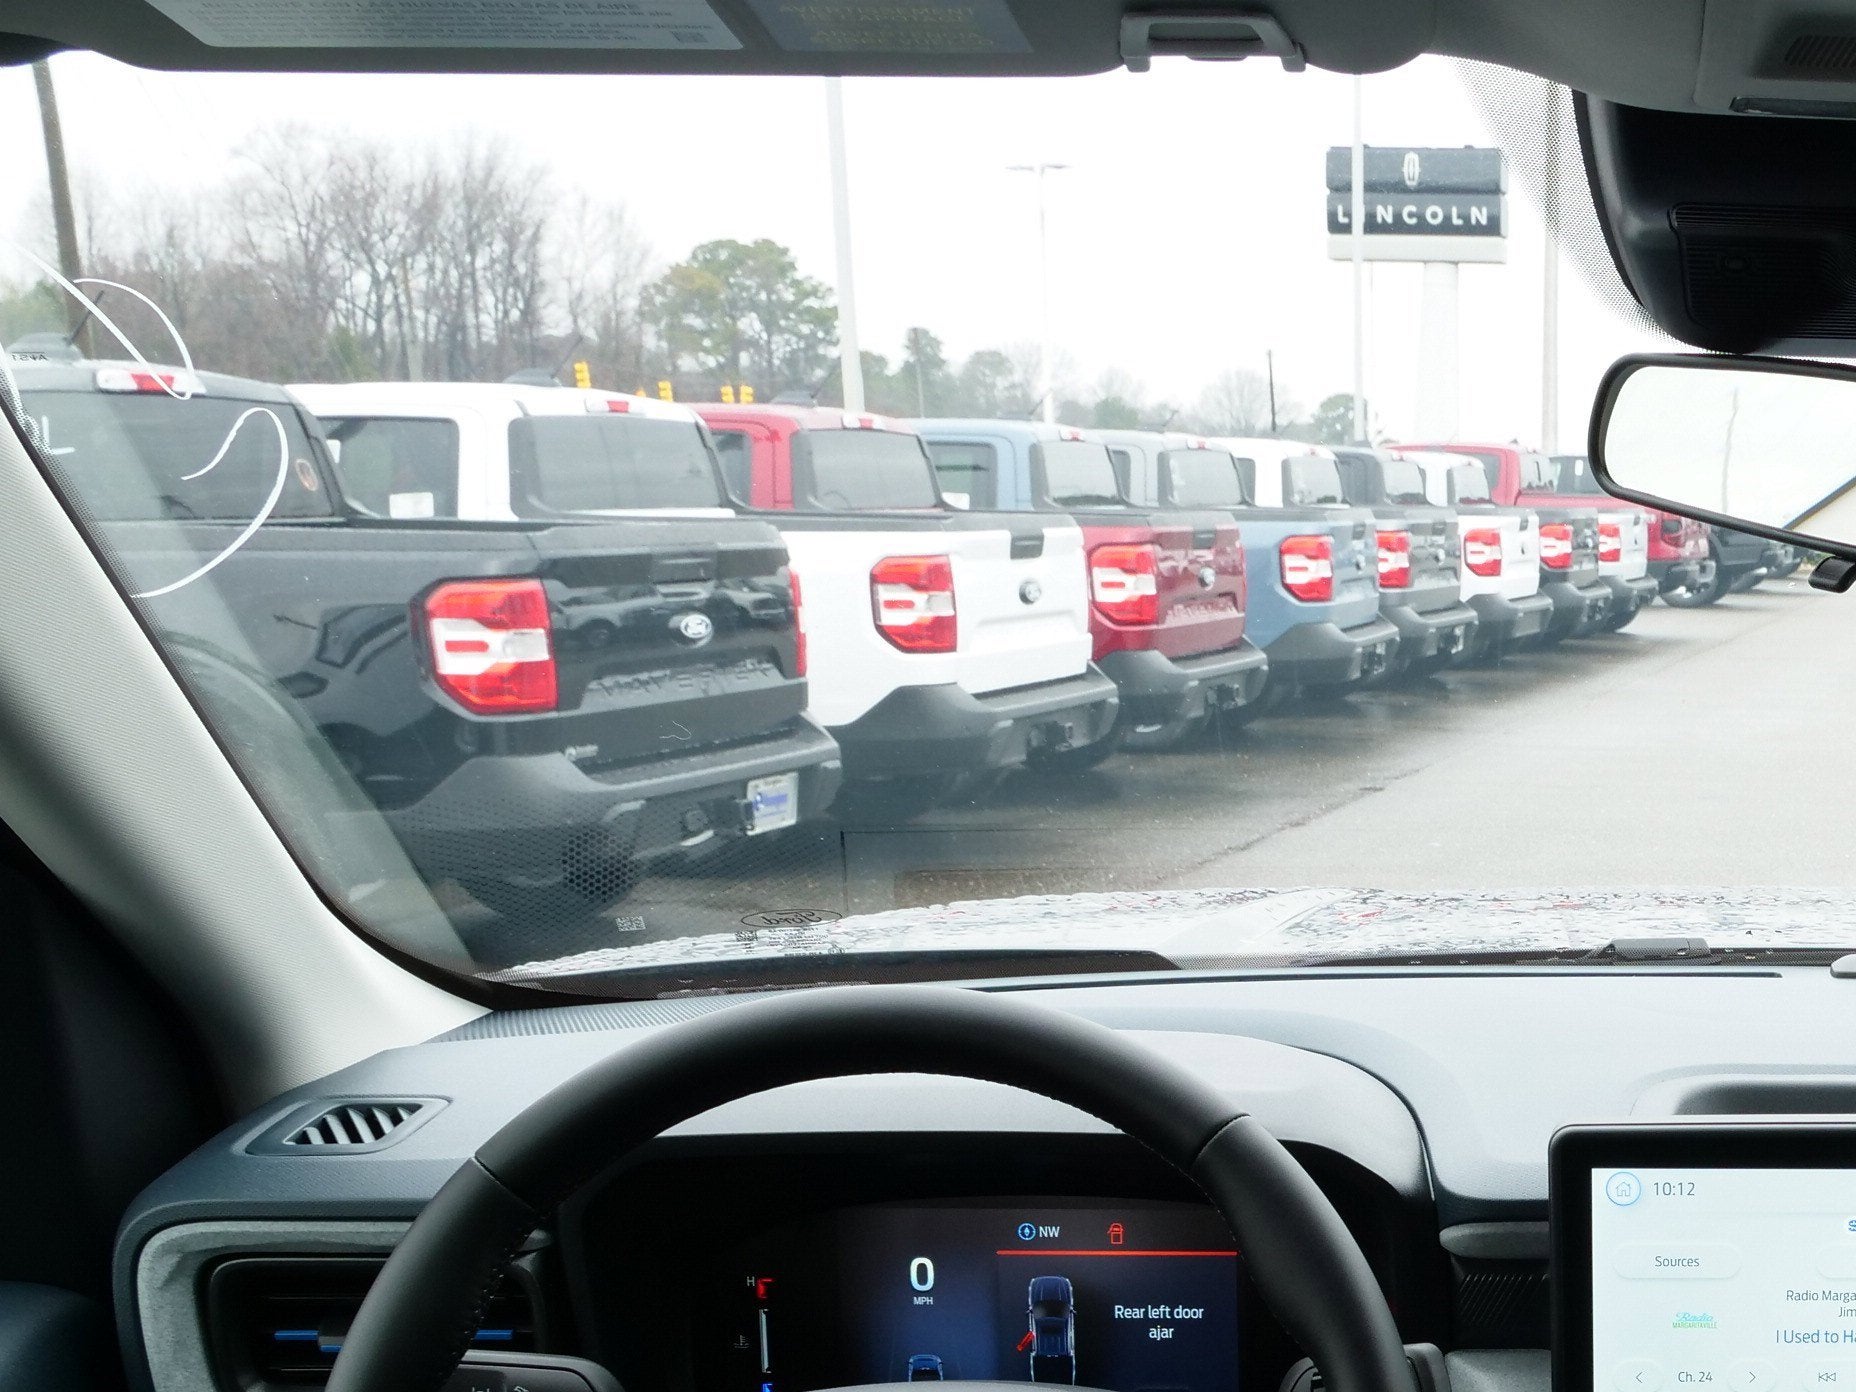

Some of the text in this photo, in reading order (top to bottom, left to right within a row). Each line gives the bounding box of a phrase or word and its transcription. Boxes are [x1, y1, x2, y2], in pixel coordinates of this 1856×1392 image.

[1337, 204, 1488, 225] LNCOLN
[1653, 1182, 1695, 1196] 10:12
[1039, 1226, 1060, 1238] NW
[1654, 1255, 1699, 1268] Sources
[747, 1277, 754, 1286] H
[910, 1258, 934, 1292] 0
[1786, 1290, 1818, 1301] Radio
[1114, 1305, 1204, 1320] Rear left door
[1149, 1325, 1174, 1341] ajar
[1776, 1330, 1779, 1343] I
[1783, 1329, 1819, 1343] Used
[1824, 1331, 1839, 1343] to
[1678, 1372, 1713, 1382] Ch. 24
